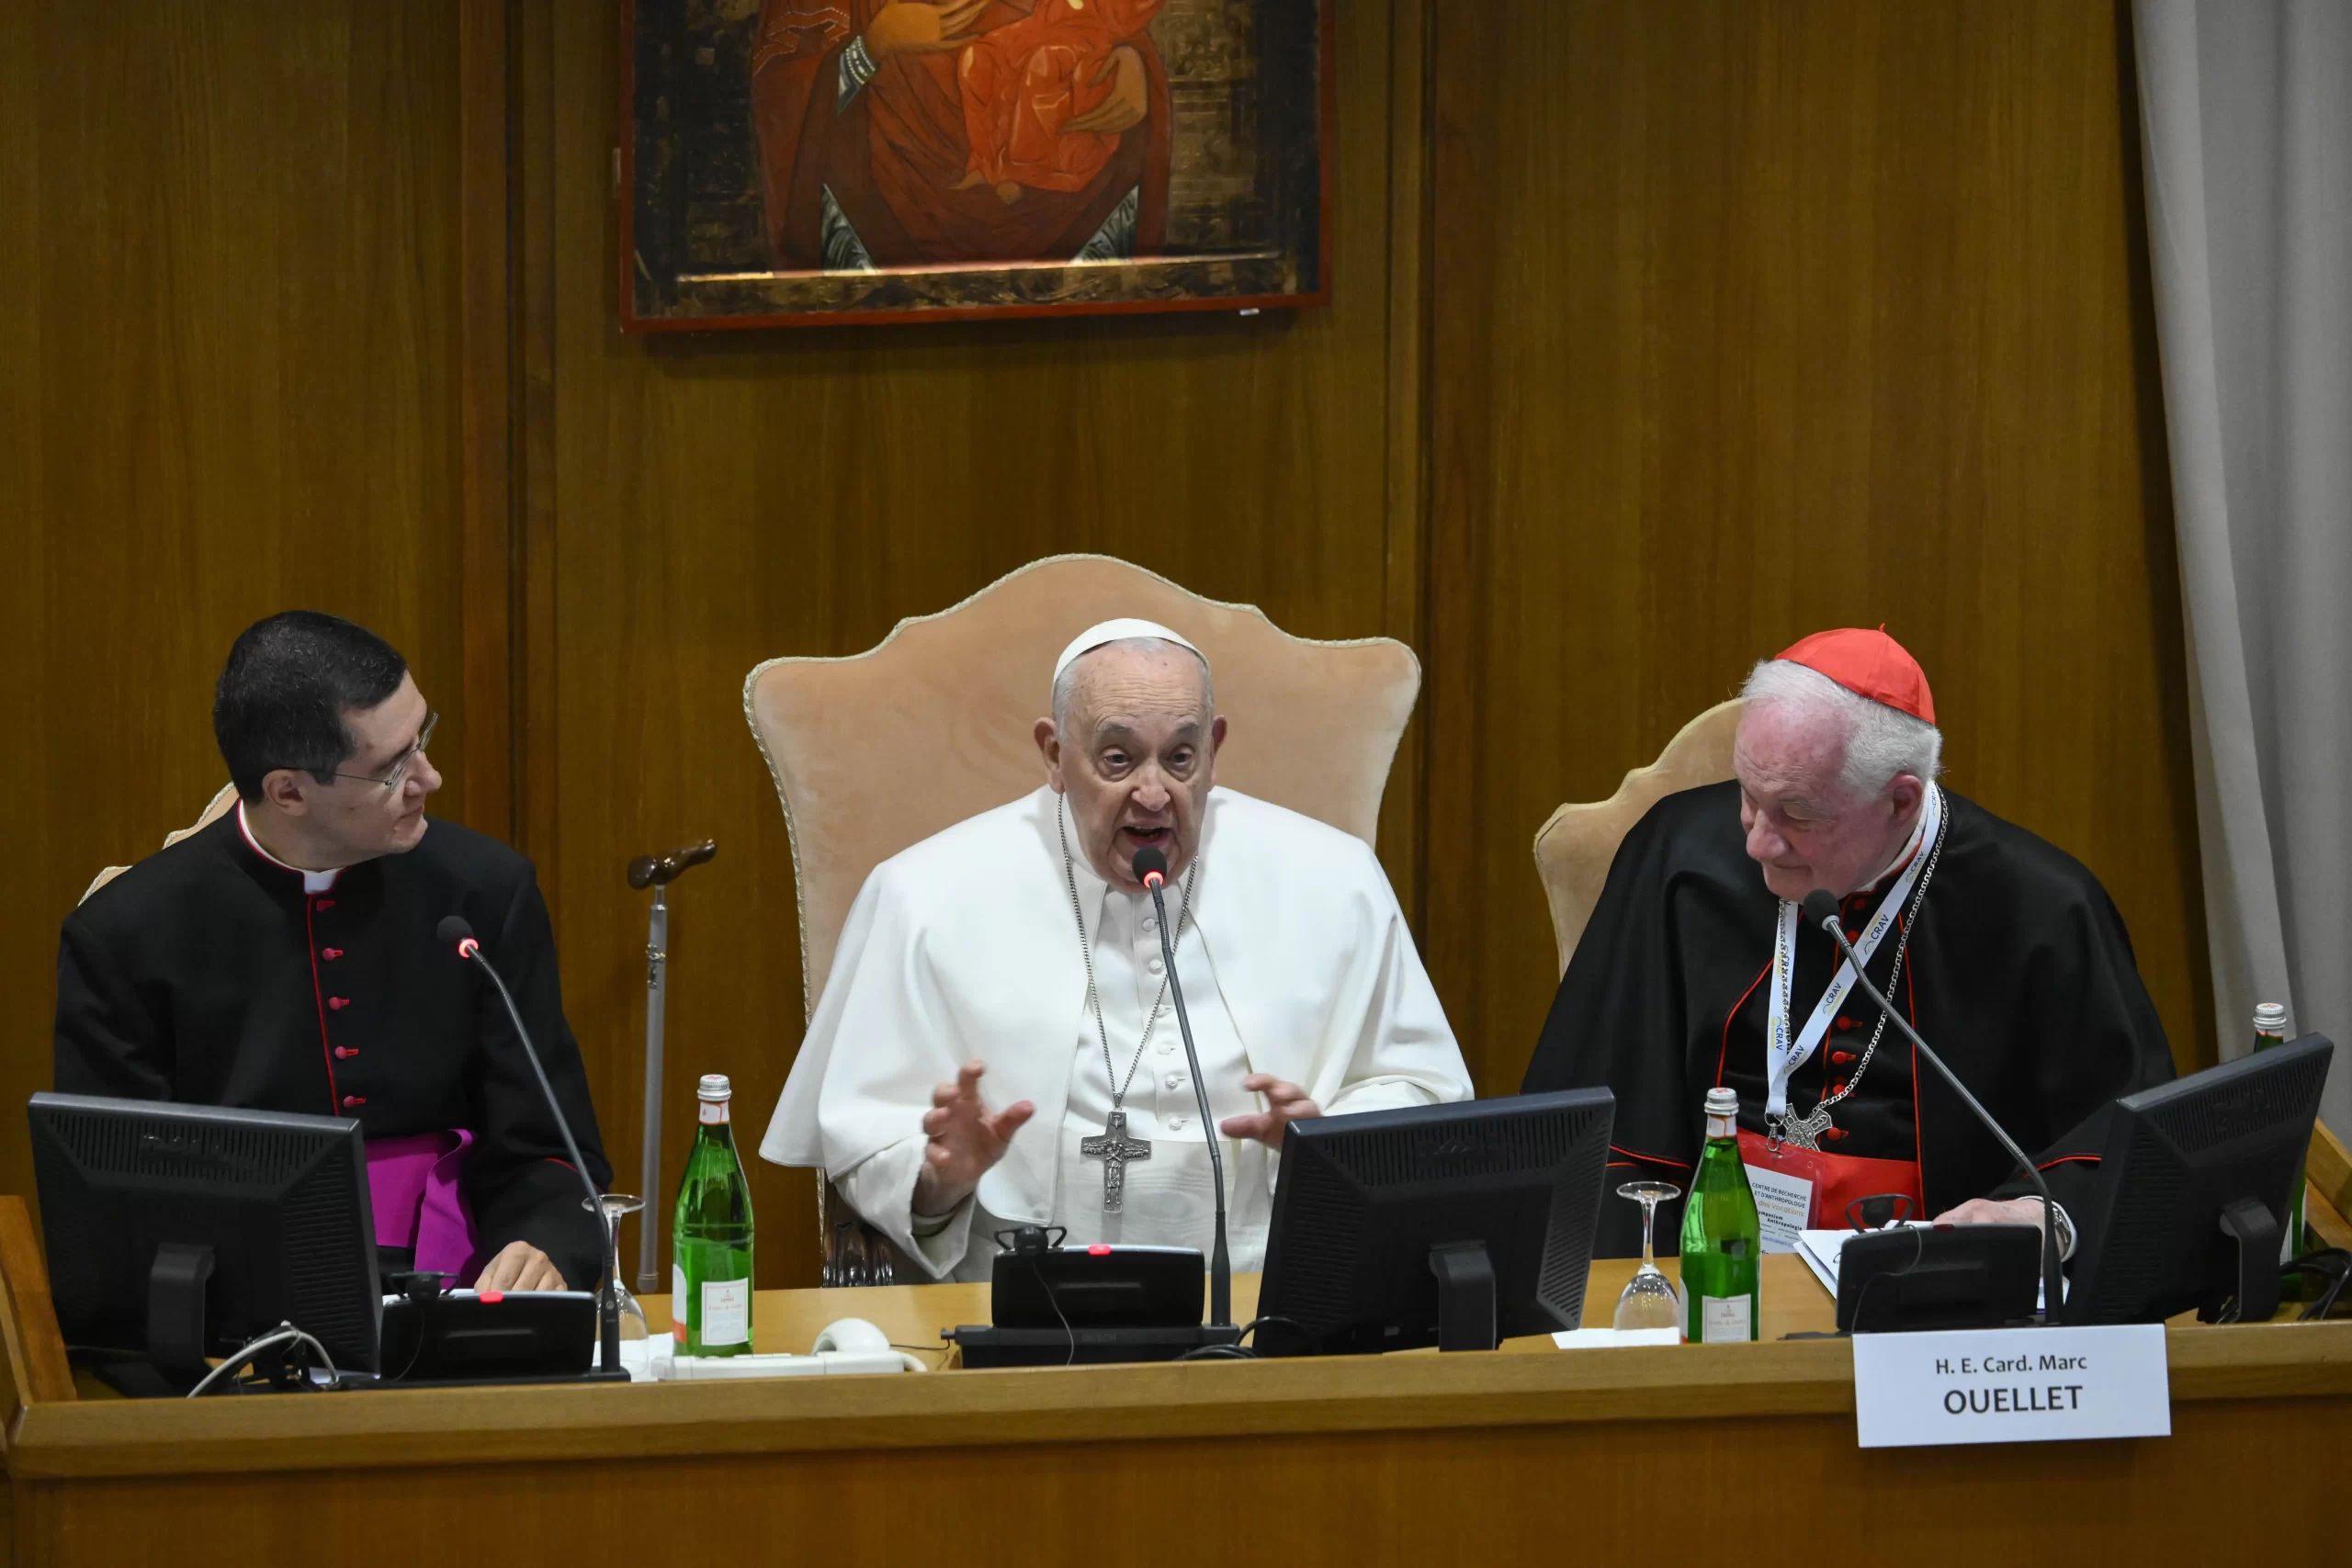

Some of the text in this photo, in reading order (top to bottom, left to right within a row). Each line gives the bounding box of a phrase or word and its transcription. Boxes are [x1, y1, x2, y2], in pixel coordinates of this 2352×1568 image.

[1911, 851, 1924, 873] CRAV
[1871, 914, 1889, 940] CRAV
[1826, 982, 1842, 1004] CRAV
[1775, 1027, 1783, 1051] CRAV
[1788, 1044, 1804, 1066] CRAV
[1752, 1182, 1770, 1192] CENTRE
[1779, 1190, 1806, 1201] RECHERCHE
[1760, 1191, 1805, 1209] D'ANTHROPOLOGIE
[1757, 1210, 1783, 1221] ymposium
[1772, 1203, 1804, 1217] Vocations
[1767, 1217, 1803, 1232] Anthropologie
[1936, 1355, 2087, 1374] H. E. Card. Marc
[1943, 1385, 2084, 1416] OUELLET
